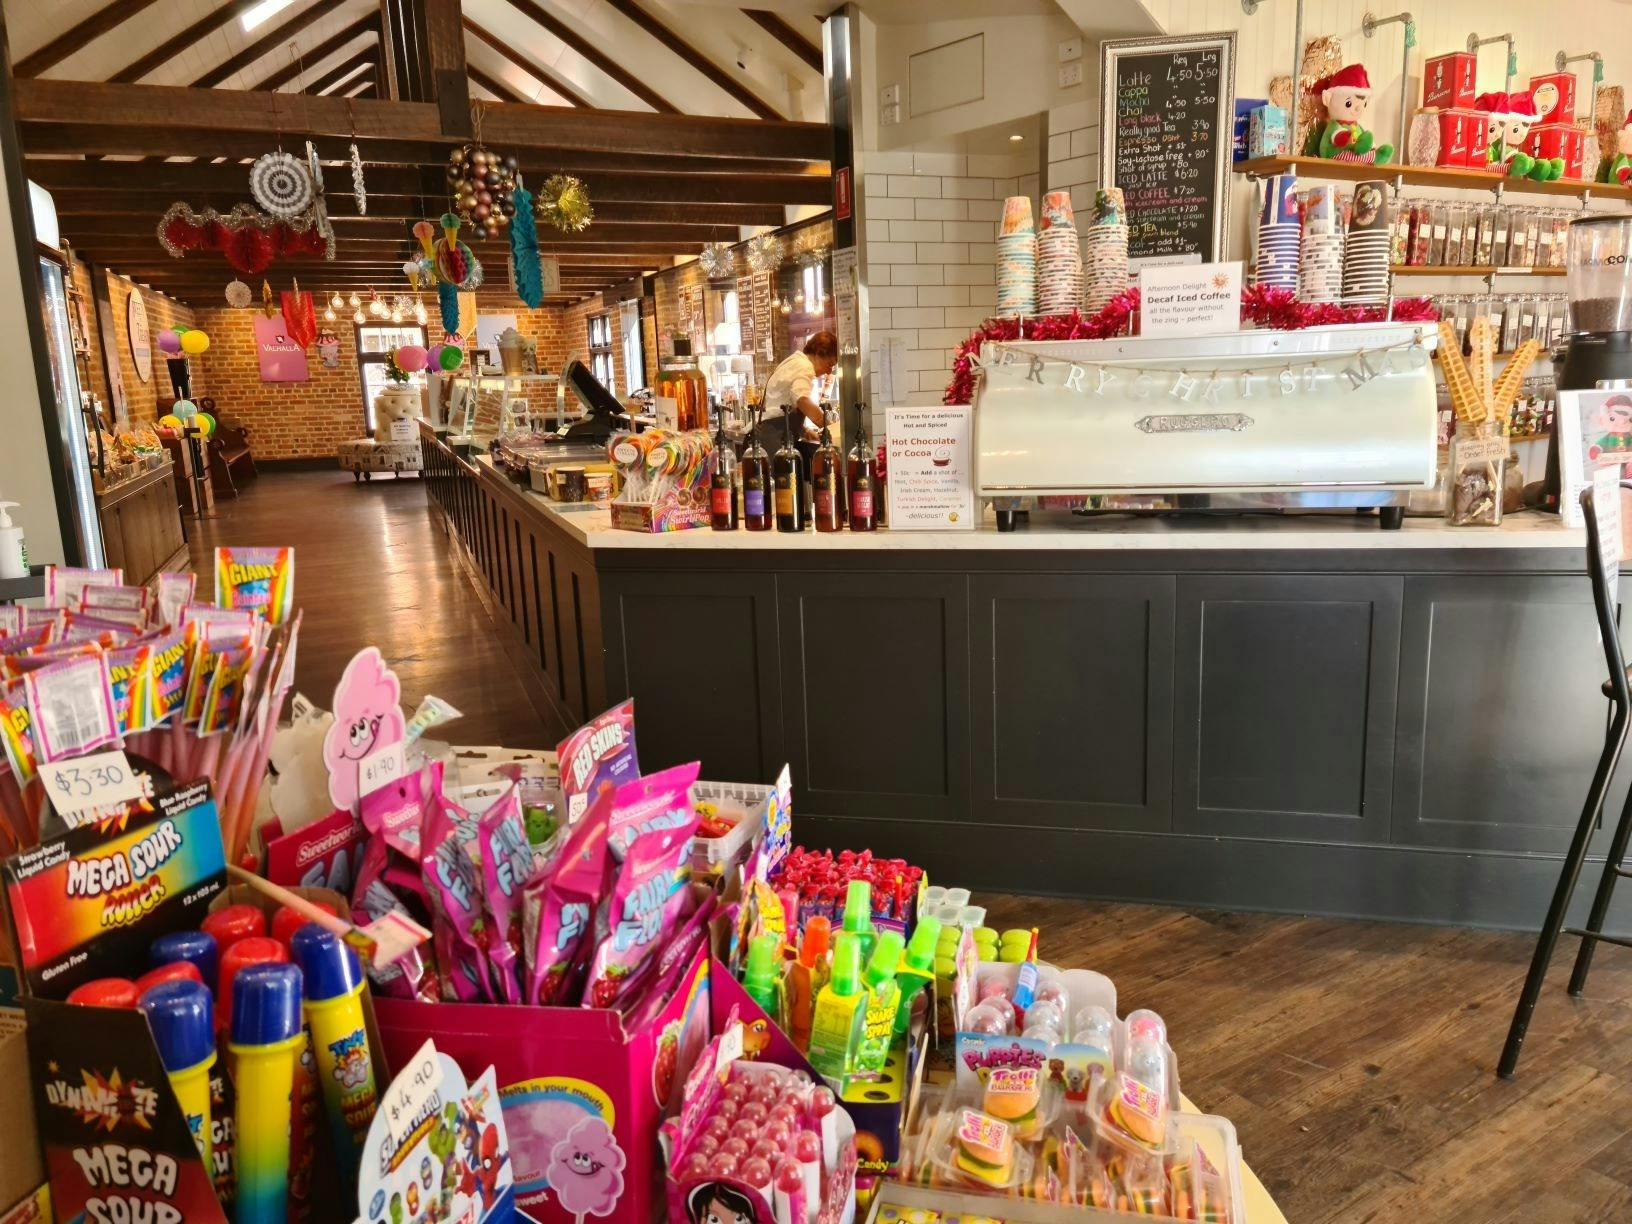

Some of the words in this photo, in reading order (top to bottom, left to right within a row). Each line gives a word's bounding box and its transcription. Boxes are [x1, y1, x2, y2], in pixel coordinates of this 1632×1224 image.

[1119, 71, 1152, 87] Latte
[1147, 295, 1174, 304] Decaf
[1177, 294, 1198, 302] Iced
[1200, 292, 1231, 301] Coffee
[263, 343, 301, 352] VALHALLA
[892, 438, 908, 446] Hot
[910, 437, 956, 445] Chocolate
[904, 449, 932, 457] Cocoa
[229, 563, 280, 586] GIANT
[590, 722, 624, 761] SKINS
[55, 765, 124, 796] $3.30
[365, 755, 395, 781] $1.90
[165, 800, 186, 817] Liquid
[186, 794, 208, 810] Candy
[17, 859, 44, 878] Liquid
[43, 850, 71, 870] Candy
[19, 840, 66, 866] Strawberry
[67, 852, 131, 897] MEGA
[130, 819, 182, 880] SOUR
[42, 957, 70, 981] Gluten
[69, 952, 88, 970] Free
[962, 1043, 1047, 1072] PUPPIES
[993, 1070, 1033, 1081] Trolli
[391, 1060, 434, 1121] $4.90
[530, 1083, 541, 1092] in
[544, 1084, 569, 1094] your
[572, 1087, 605, 1111] mouth
[72, 1144, 178, 1196] MEGA
[85, 1196, 182, 1224] SOUR
